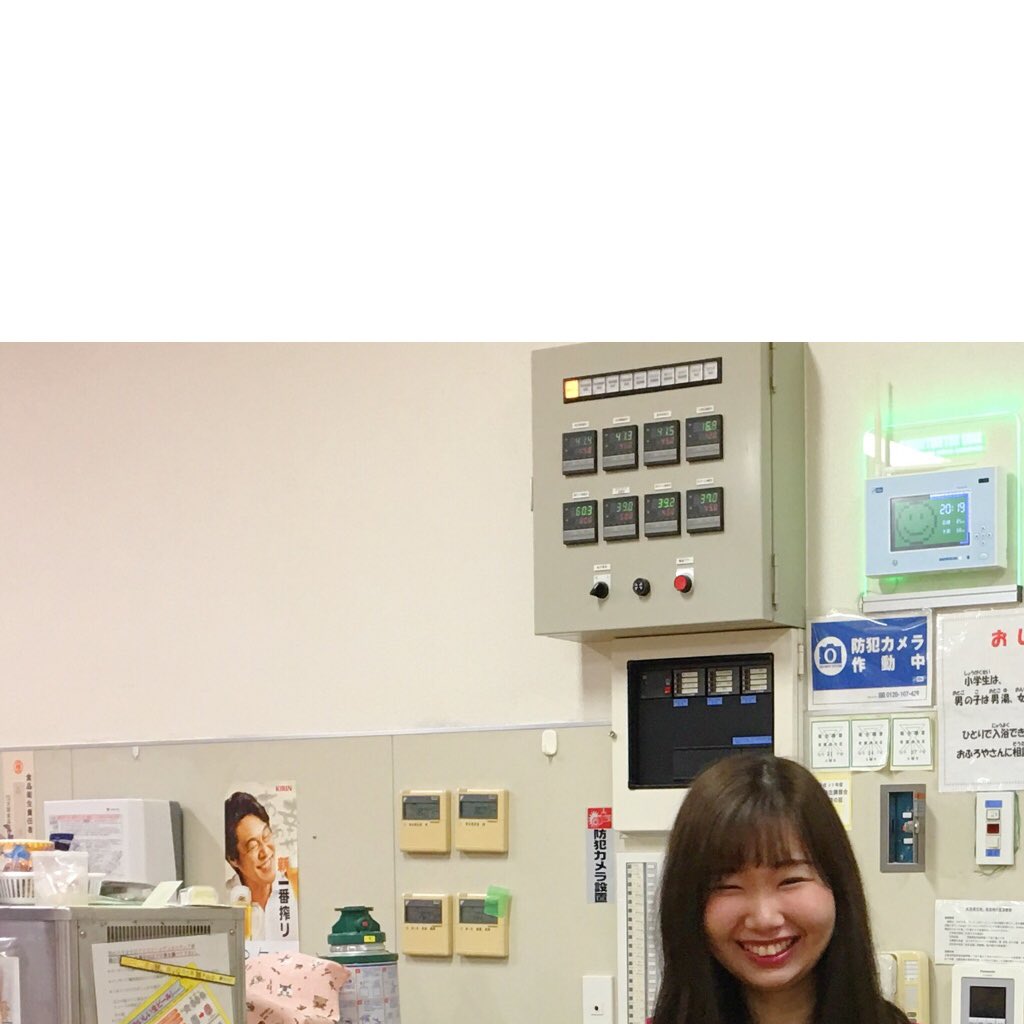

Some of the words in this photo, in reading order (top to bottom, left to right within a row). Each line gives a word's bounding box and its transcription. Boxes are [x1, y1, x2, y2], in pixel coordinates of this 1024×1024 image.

[939, 502, 965, 515] 20:19
[851, 635, 924, 654] 防犯カメラ
[852, 654, 925, 673] 作動中
[593, 829, 608, 903] 防犯カメラ設置
[278, 880, 291, 937] 一番搾り
